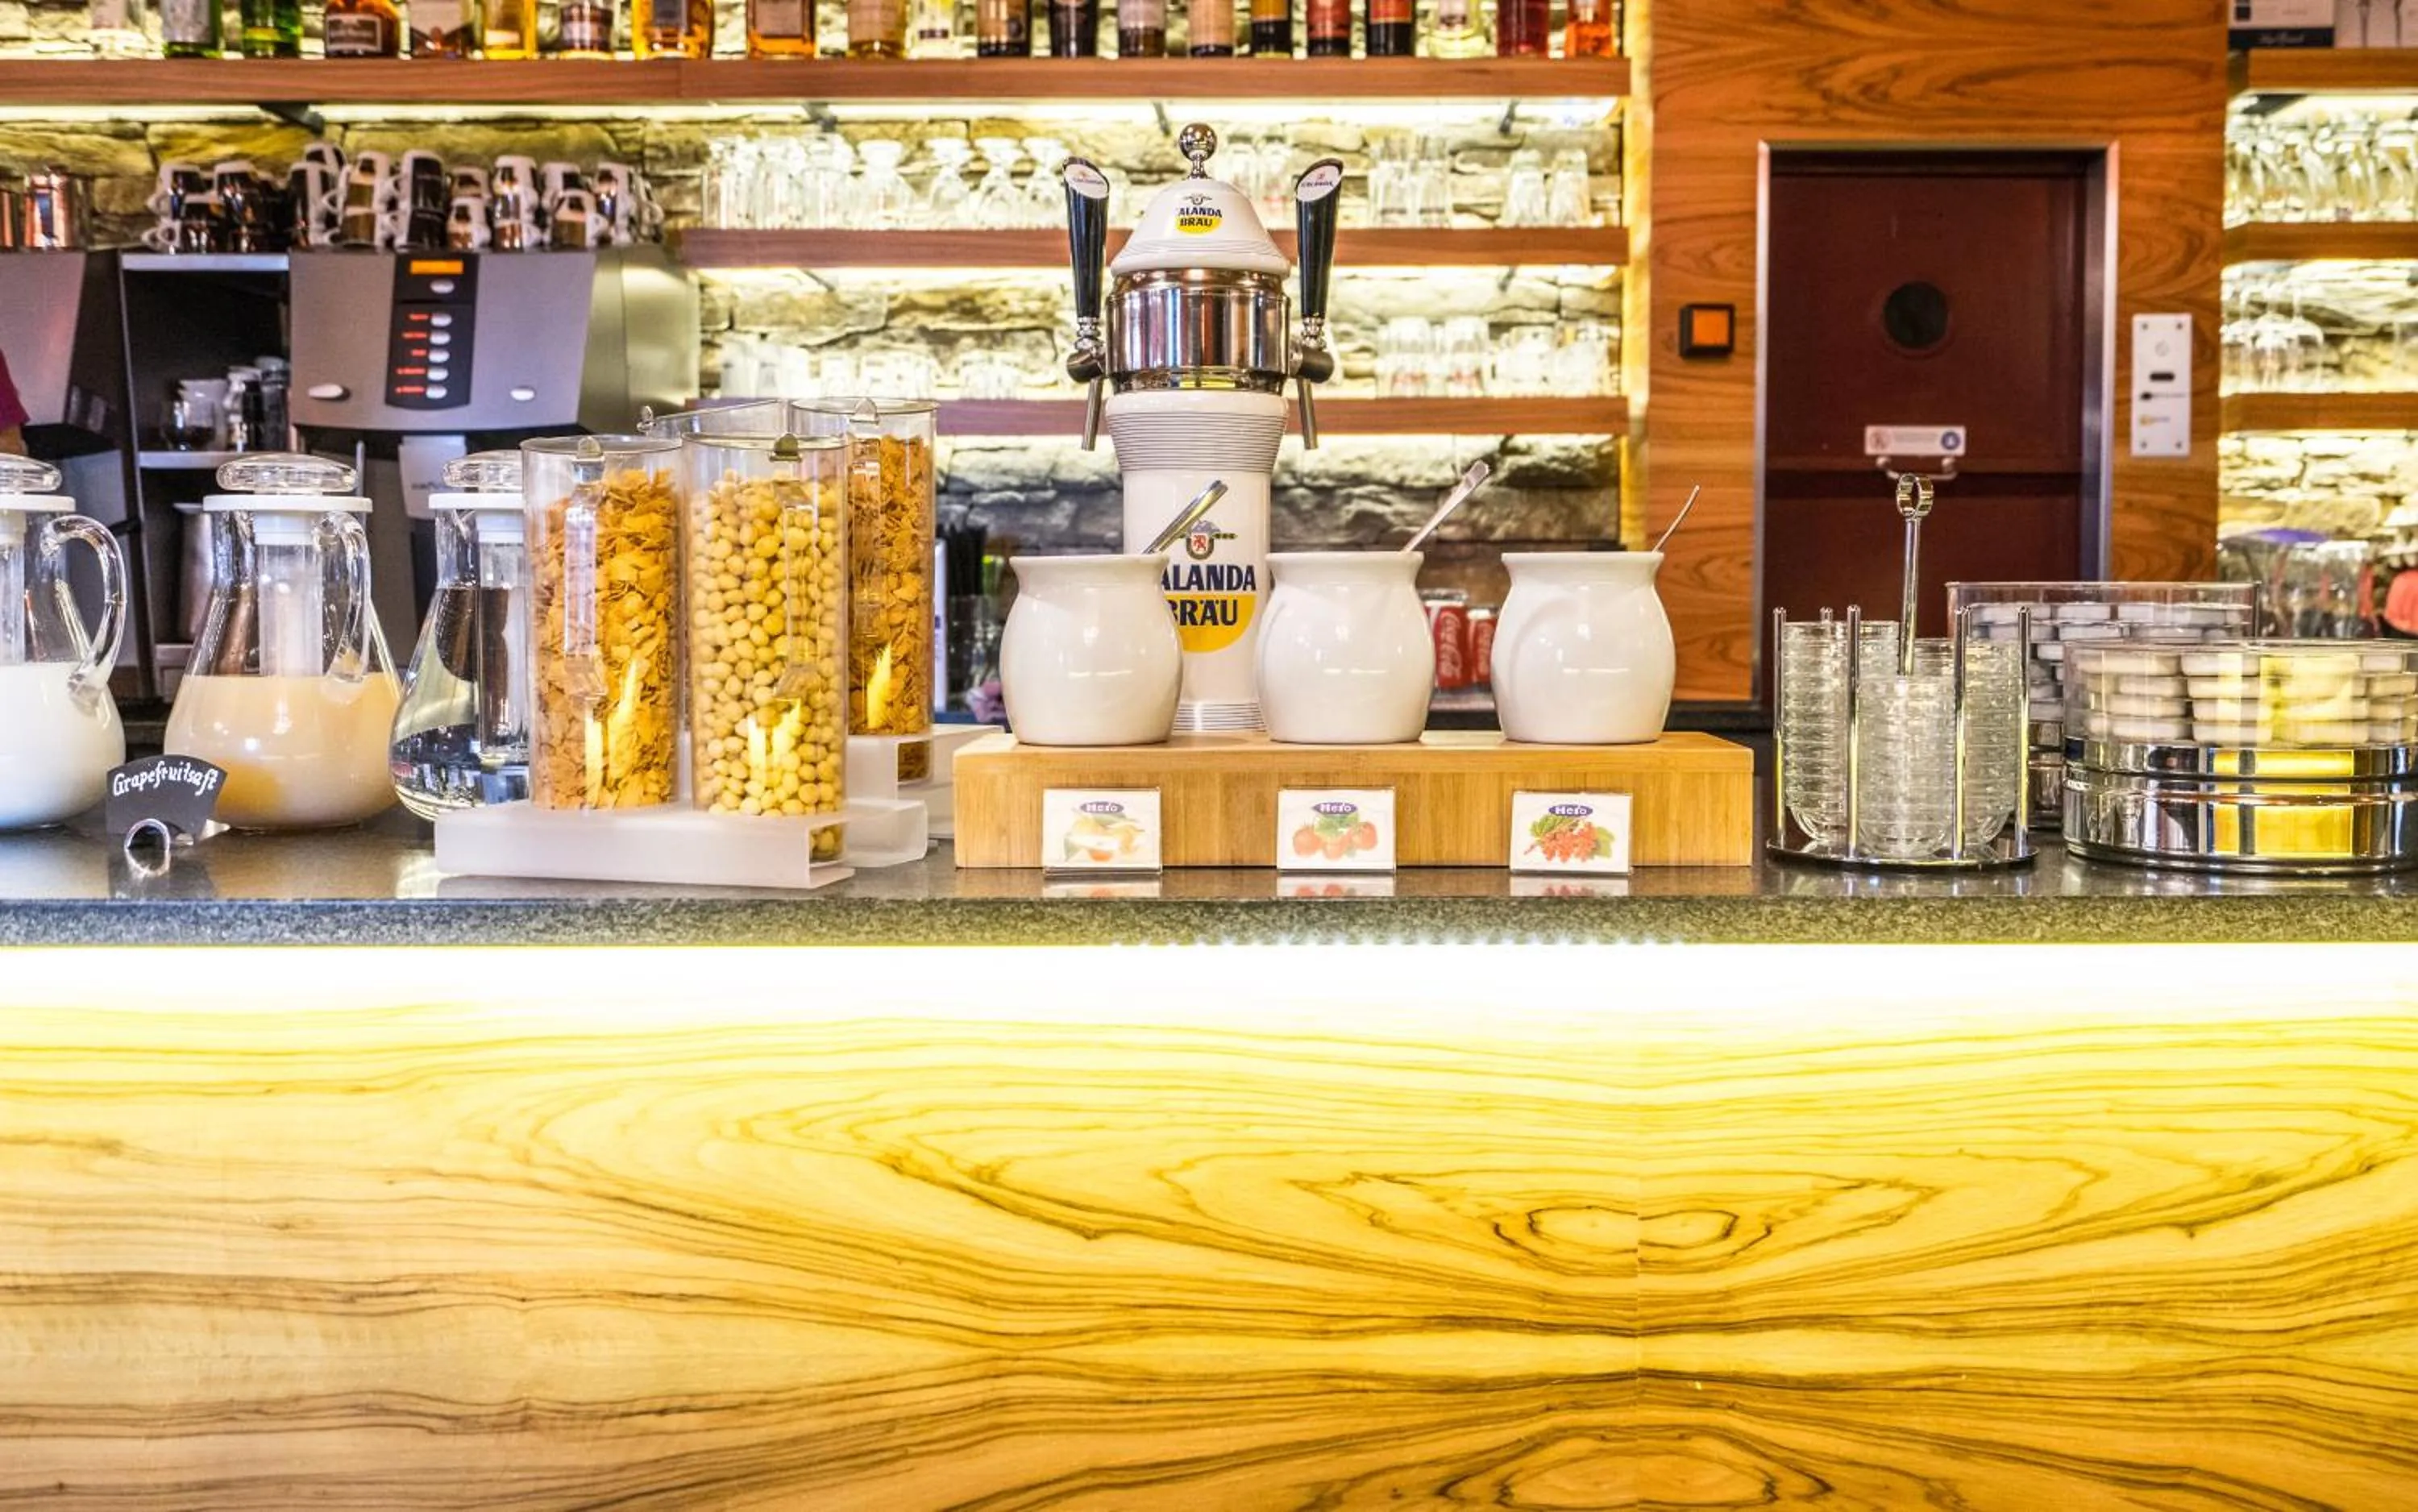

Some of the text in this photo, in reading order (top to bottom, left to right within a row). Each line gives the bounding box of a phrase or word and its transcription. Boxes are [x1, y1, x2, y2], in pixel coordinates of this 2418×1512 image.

[1176, 206, 1223, 218] ALANDA
[1161, 564, 1257, 592] ALANDA
[112, 760, 218, 797] Grapefruitsaft
[1319, 802, 1352, 813] Hero
[1555, 804, 1588, 815] Hero
